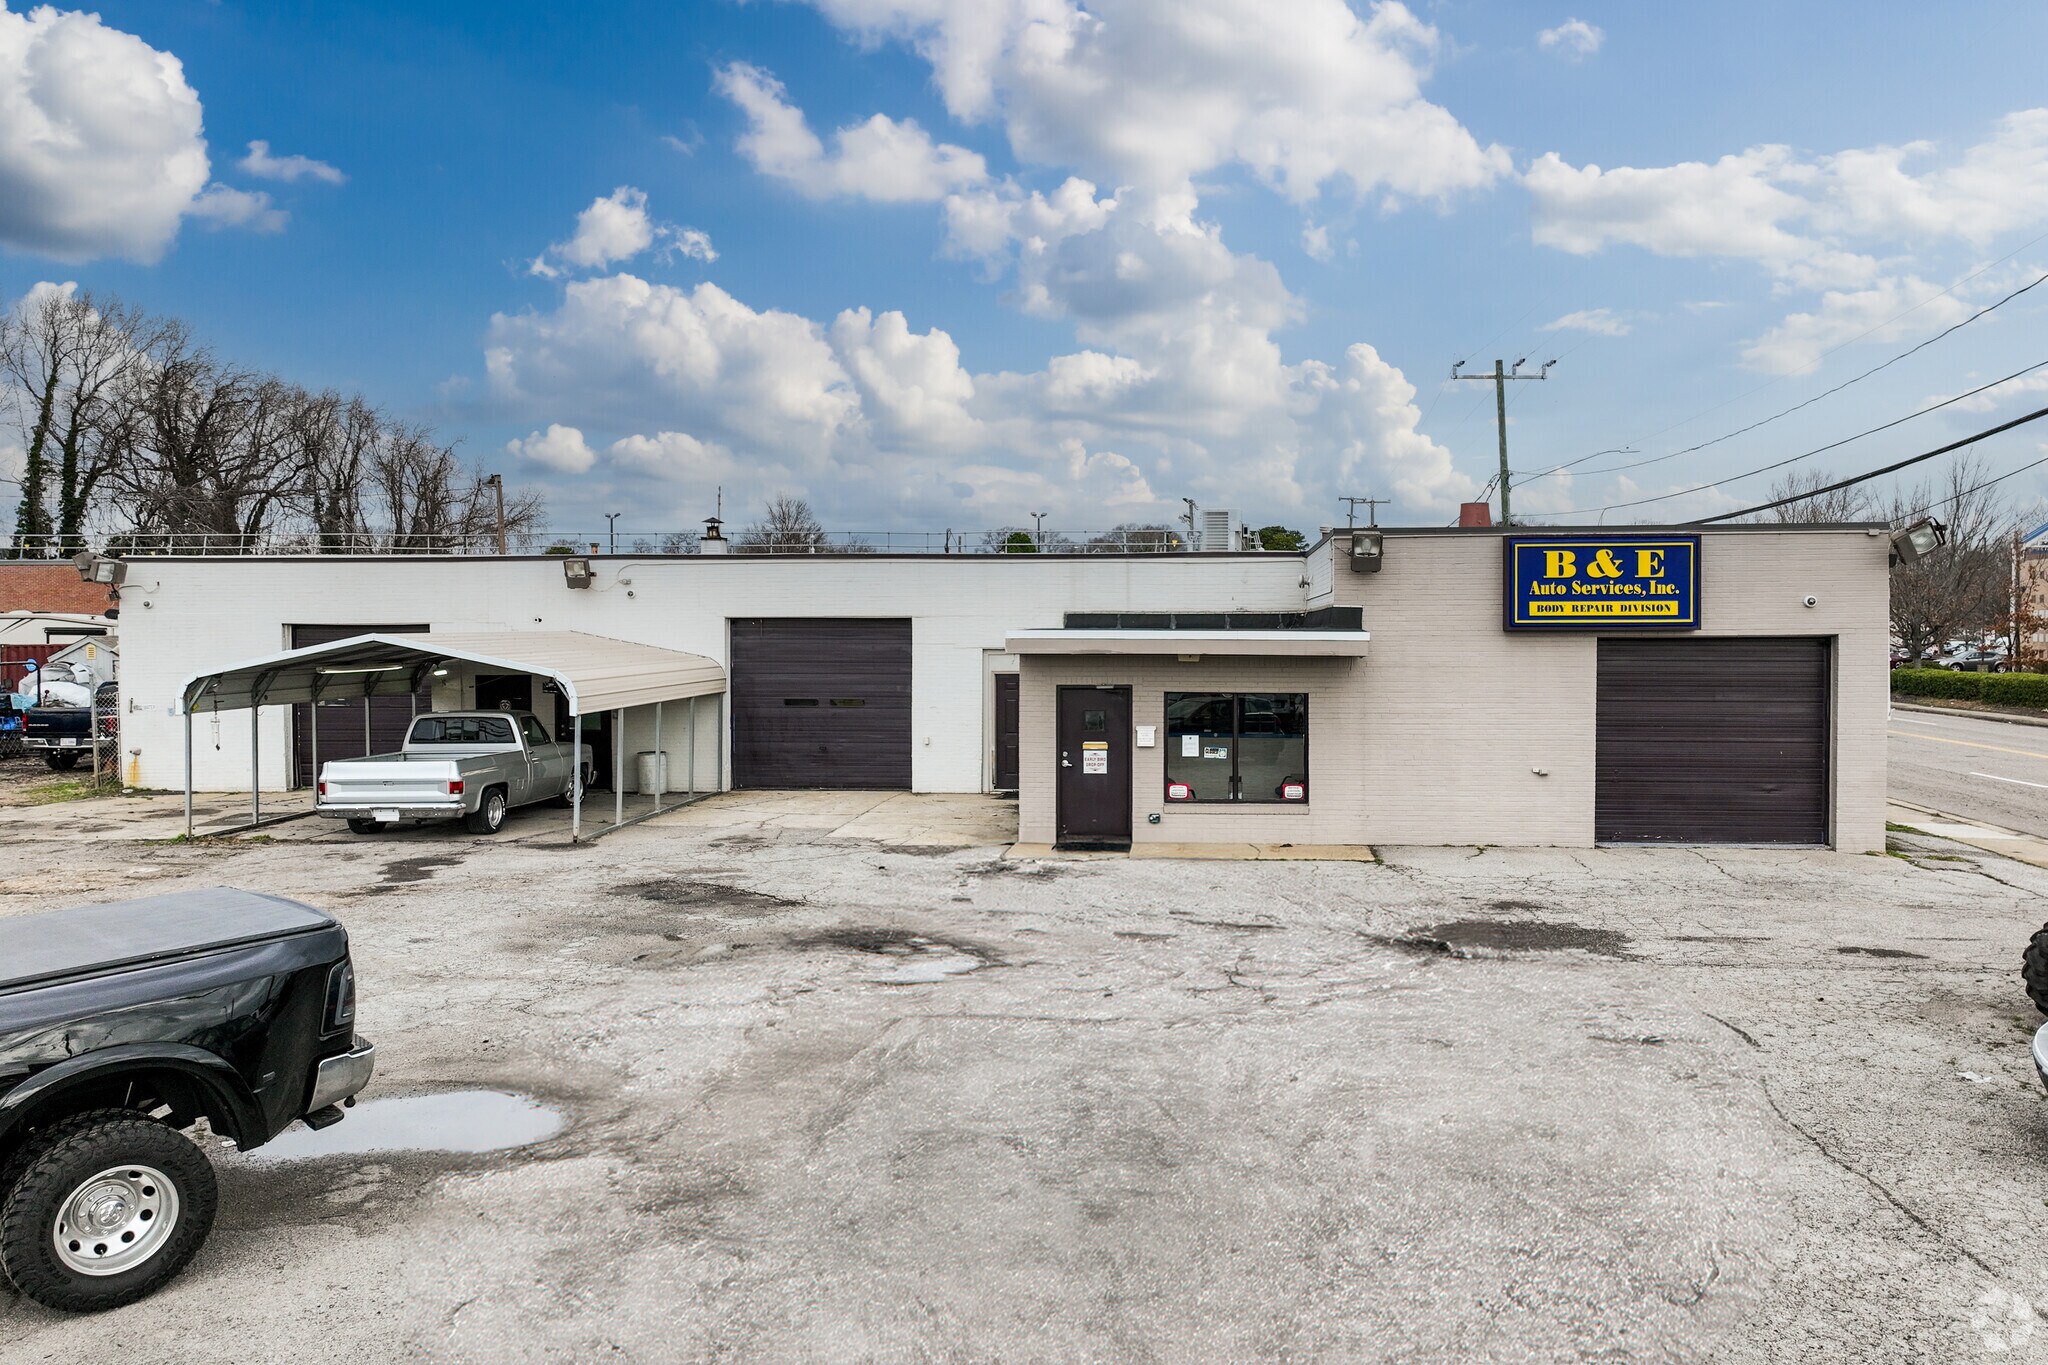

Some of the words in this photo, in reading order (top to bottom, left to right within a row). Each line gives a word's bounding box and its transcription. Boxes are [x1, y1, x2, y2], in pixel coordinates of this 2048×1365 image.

[1543, 550, 1576, 578] B
[1586, 549, 1624, 578] &
[1635, 550, 1665, 578] E
[1529, 581, 1567, 595] Auto
[1571, 580, 1646, 597] Services,
[1649, 580, 1680, 595] Inc.
[1536, 604, 1565, 613] BODY
[1571, 604, 1614, 613] REPAIR
[1620, 603, 1671, 612] DIVISION
